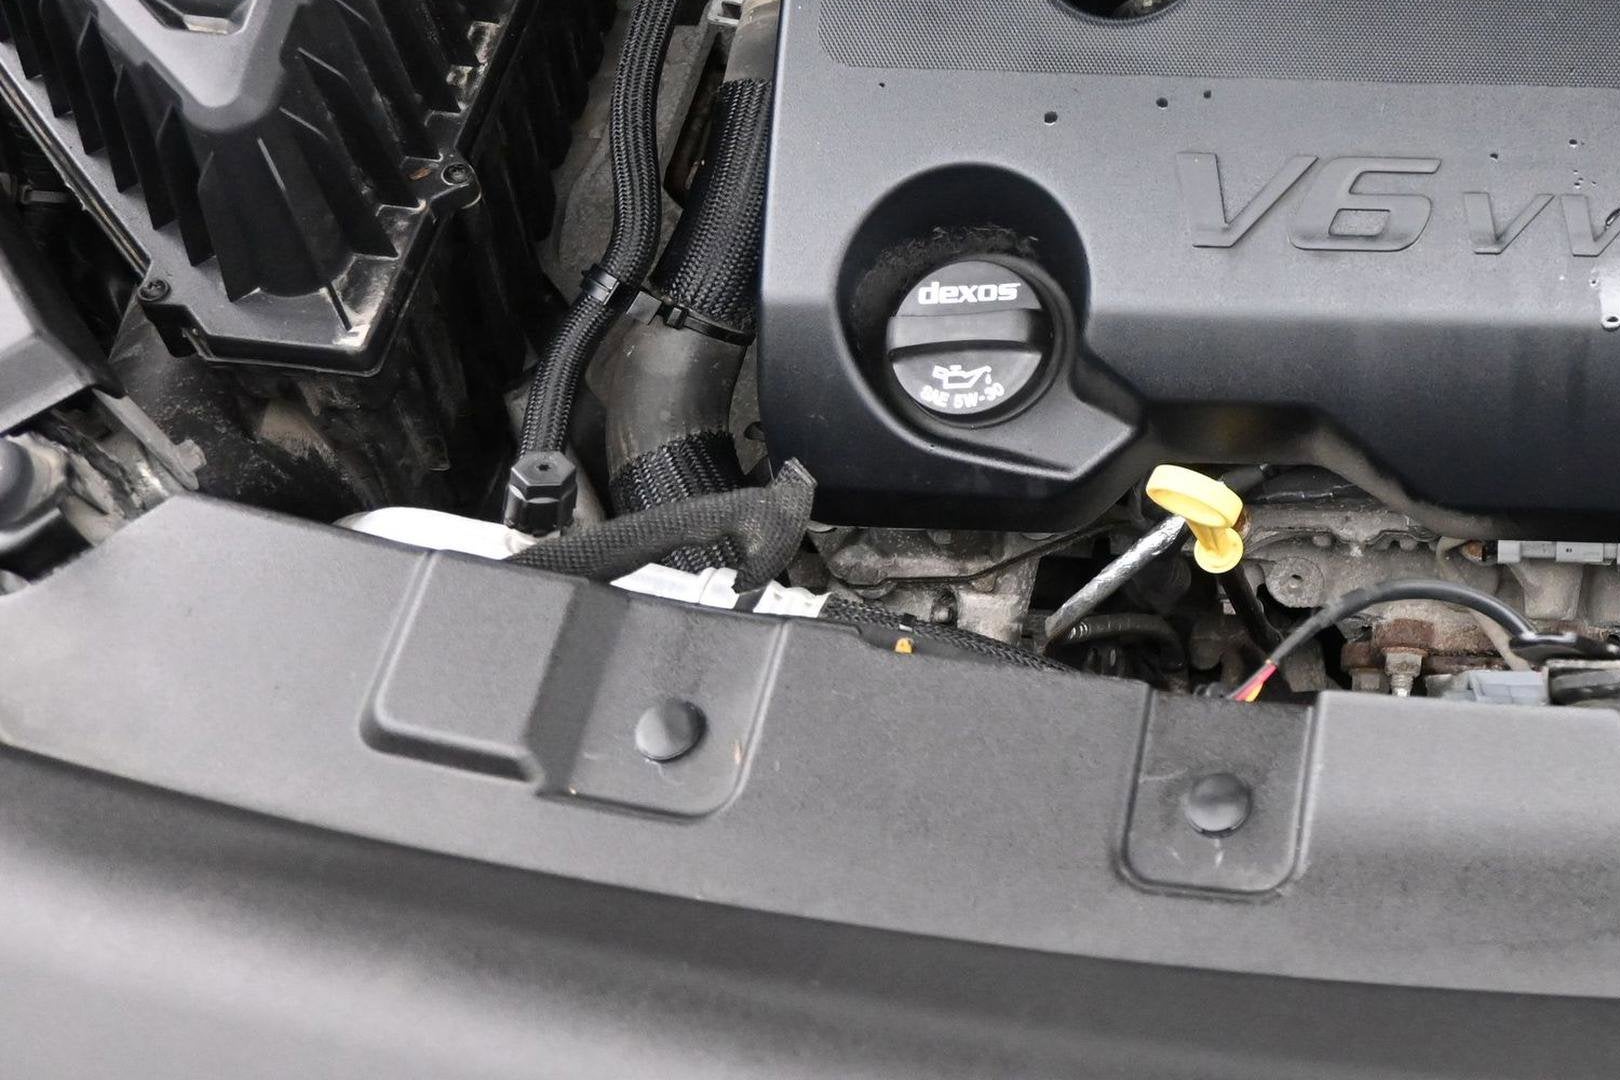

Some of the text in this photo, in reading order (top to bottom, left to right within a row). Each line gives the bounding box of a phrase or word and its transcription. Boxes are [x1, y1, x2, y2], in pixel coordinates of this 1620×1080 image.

[1177, 150, 1442, 253] V6
[917, 281, 1022, 305] dexos
[919, 381, 1006, 409] SAE 5W-30
